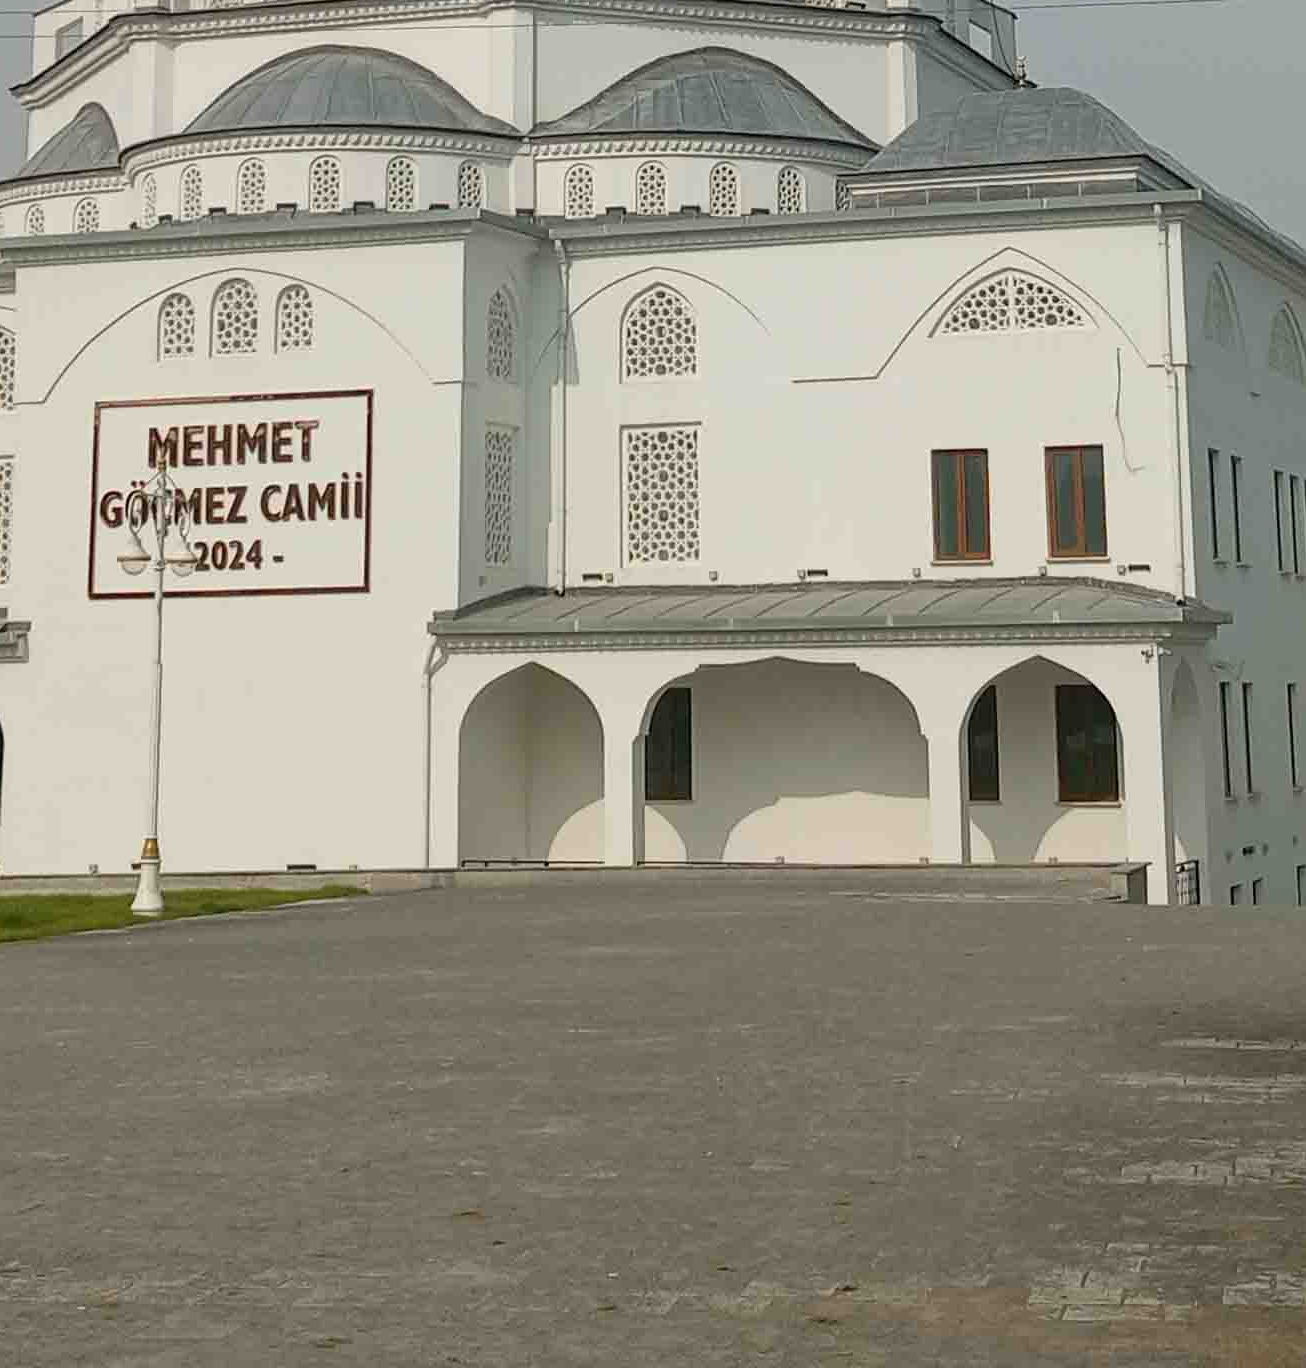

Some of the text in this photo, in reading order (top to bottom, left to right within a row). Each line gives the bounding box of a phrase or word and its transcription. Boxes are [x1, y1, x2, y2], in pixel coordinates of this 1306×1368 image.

[147, 420, 319, 468] MEHMET
[260, 472, 364, 522] CAMİİ
[194, 539, 263, 572] 2024
